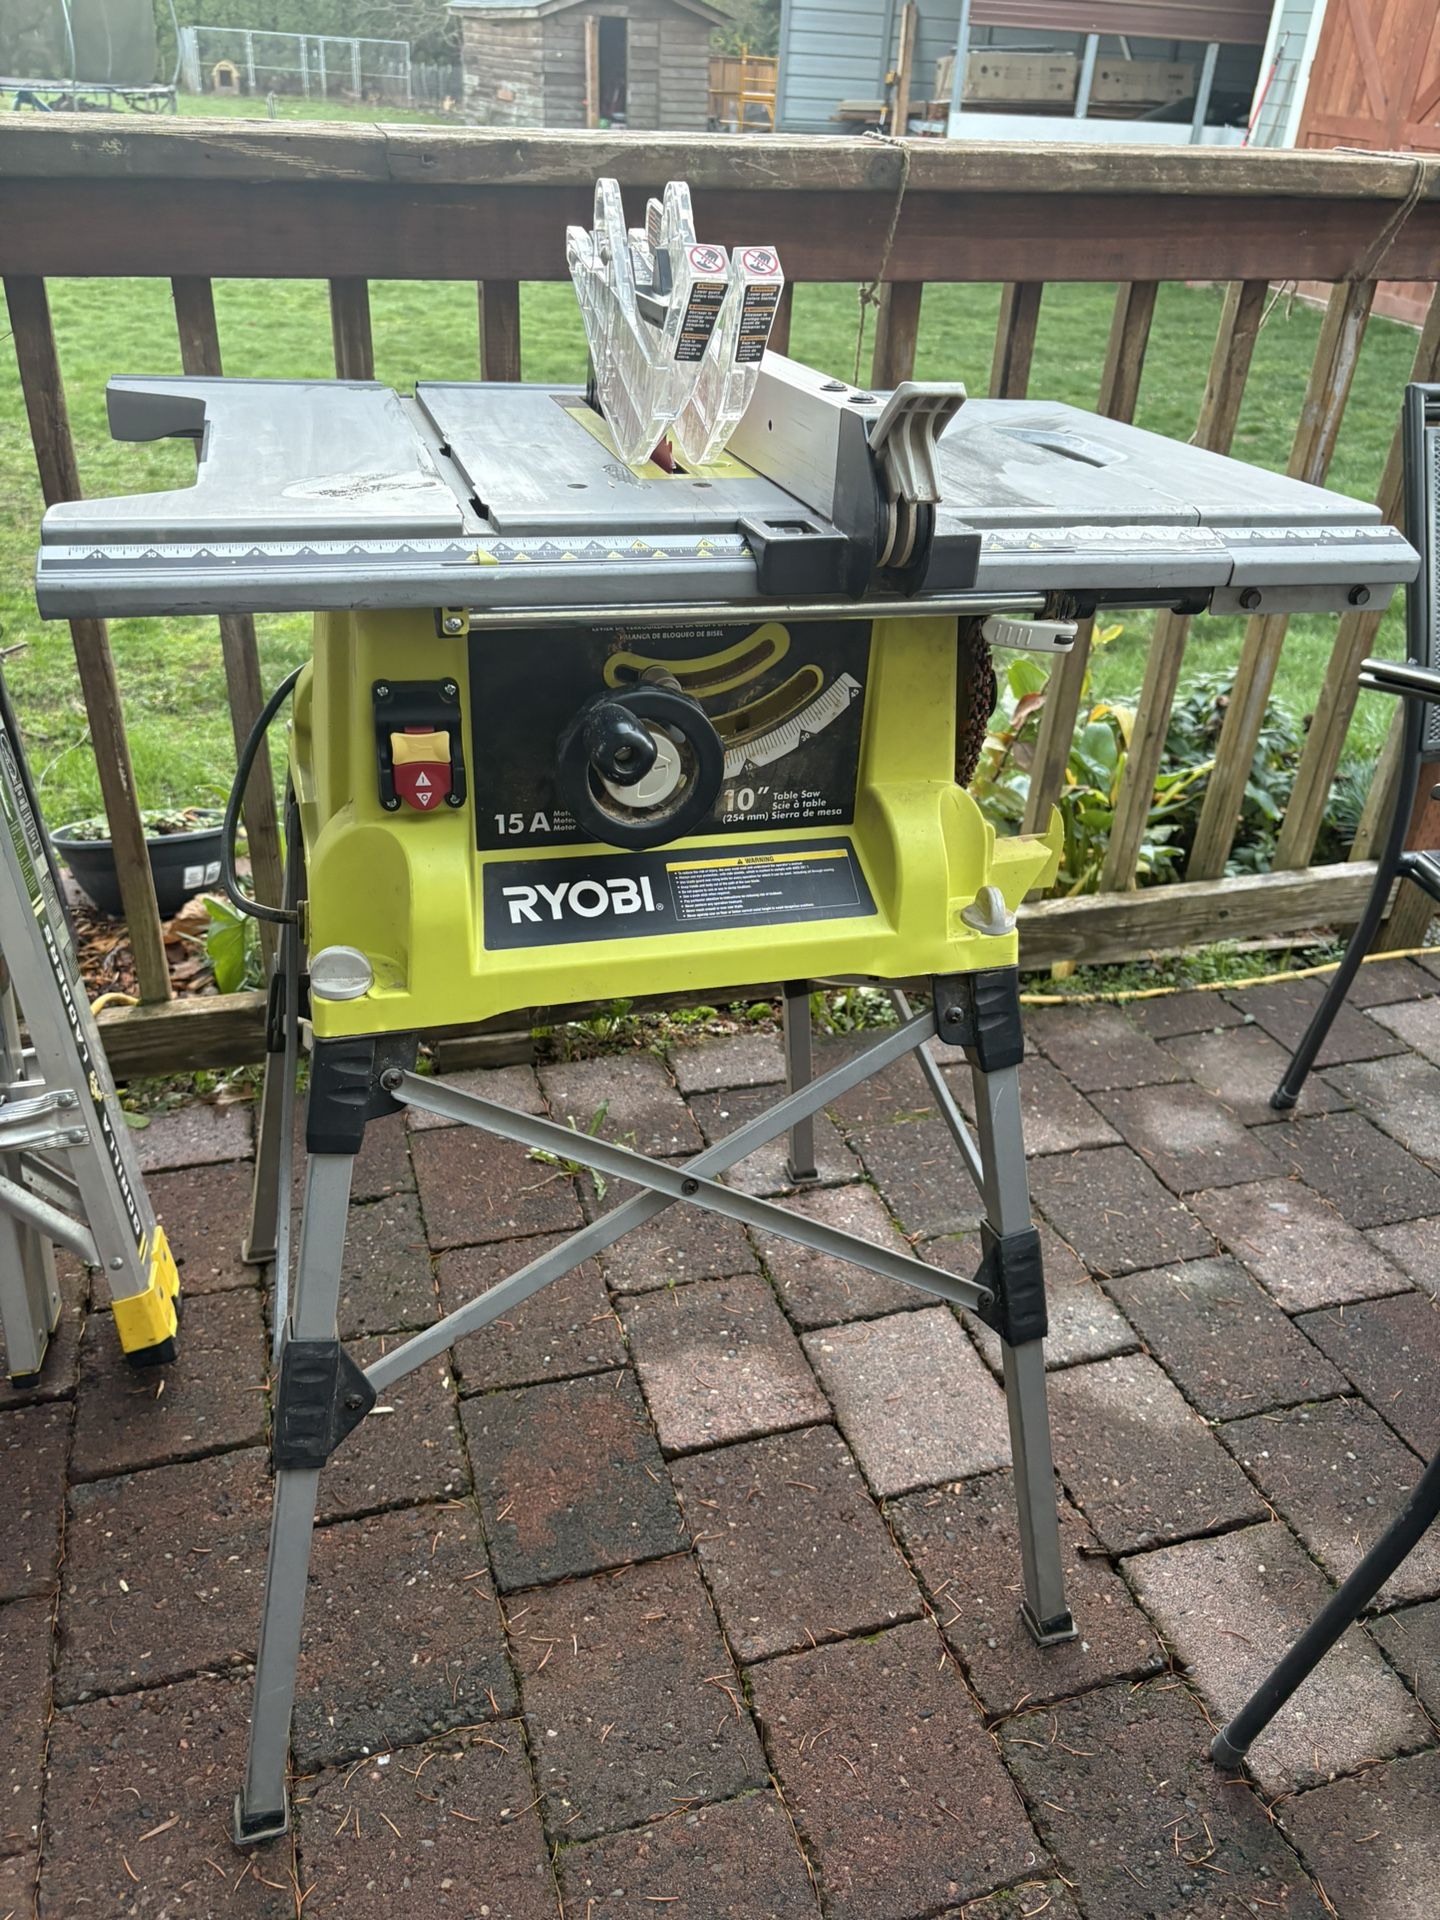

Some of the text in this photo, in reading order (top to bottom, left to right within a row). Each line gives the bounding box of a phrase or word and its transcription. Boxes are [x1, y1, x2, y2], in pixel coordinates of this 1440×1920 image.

[662, 631, 695, 639] BLOQUEO
[850, 688, 860, 699] 45
[801, 732, 810, 742] 30
[773, 789, 821, 801] Table Saw
[772, 799, 827, 811] Scie à table
[722, 811, 769, 824] (254 mm)
[771, 807, 843, 820] Sierra de mesa
[494, 811, 551, 835] 15 A
[744, 855, 775, 864] WARNING
[502, 875, 655, 924] RYOBI
[43, 923, 89, 1063] LADDERS
[103, 1111, 141, 1236] GORILLA
